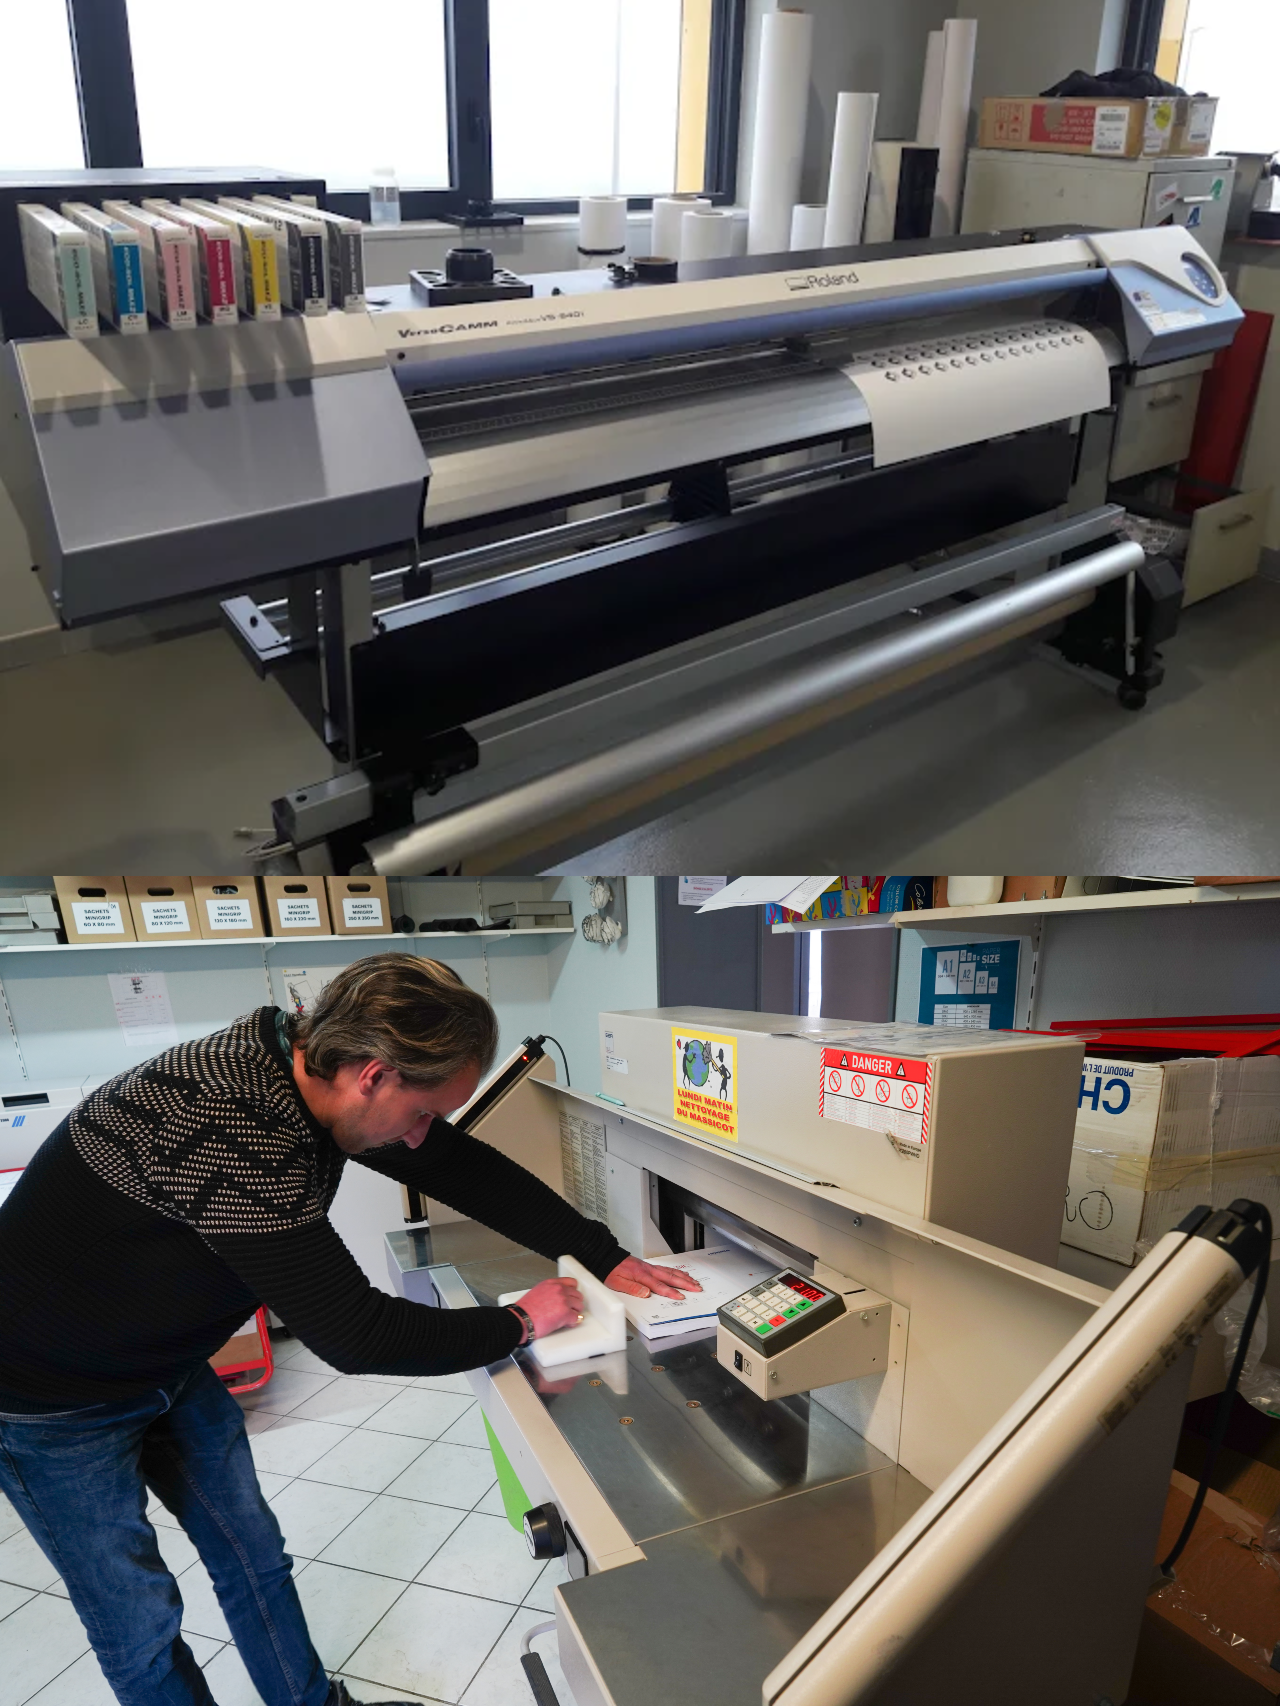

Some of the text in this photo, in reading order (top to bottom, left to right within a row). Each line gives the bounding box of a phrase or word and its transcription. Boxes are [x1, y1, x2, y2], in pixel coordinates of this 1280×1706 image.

[806, 269, 860, 289] Roland
[942, 959, 953, 973] A1
[981, 954, 1000, 964] SIZE
[963, 969, 971, 979] A2
[852, 1055, 892, 1074] DANGER
[1093, 1064, 1102, 1074] DE
[1103, 1066, 1134, 1078] PRODUIT
[678, 1089, 732, 1113] LUNDI MATIN
[680, 1099, 730, 1122] NETTOYAGE
[676, 1108, 734, 1134] DU MASSICOT
